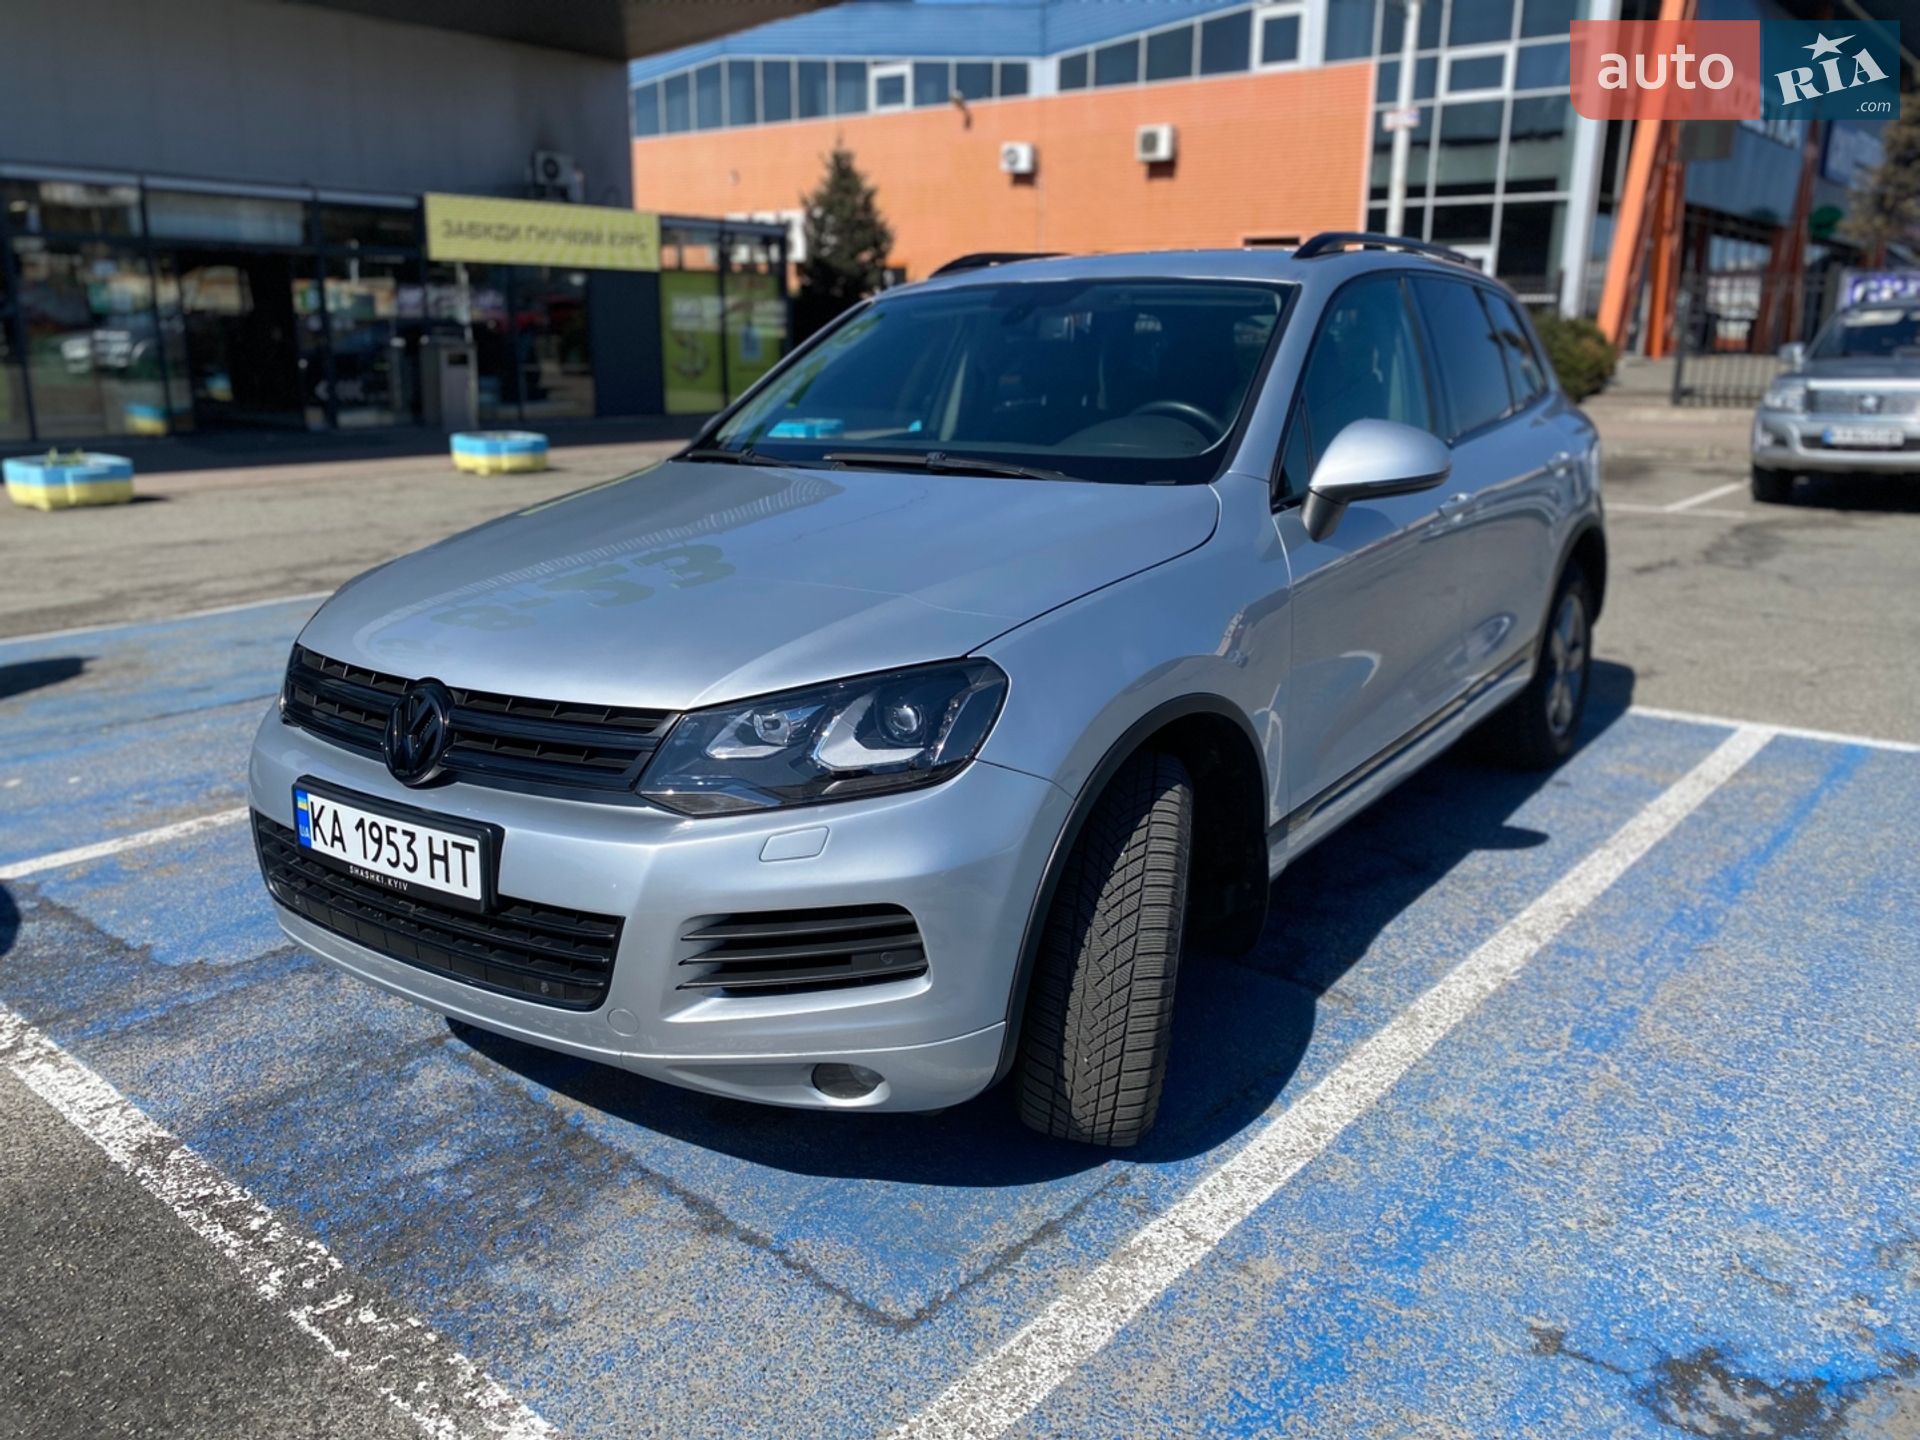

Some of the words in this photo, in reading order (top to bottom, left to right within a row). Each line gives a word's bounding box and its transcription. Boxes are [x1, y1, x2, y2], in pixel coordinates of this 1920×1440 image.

[310, 801, 347, 853] KA
[354, 817, 419, 874] 1953
[428, 836, 476, 888] HT
